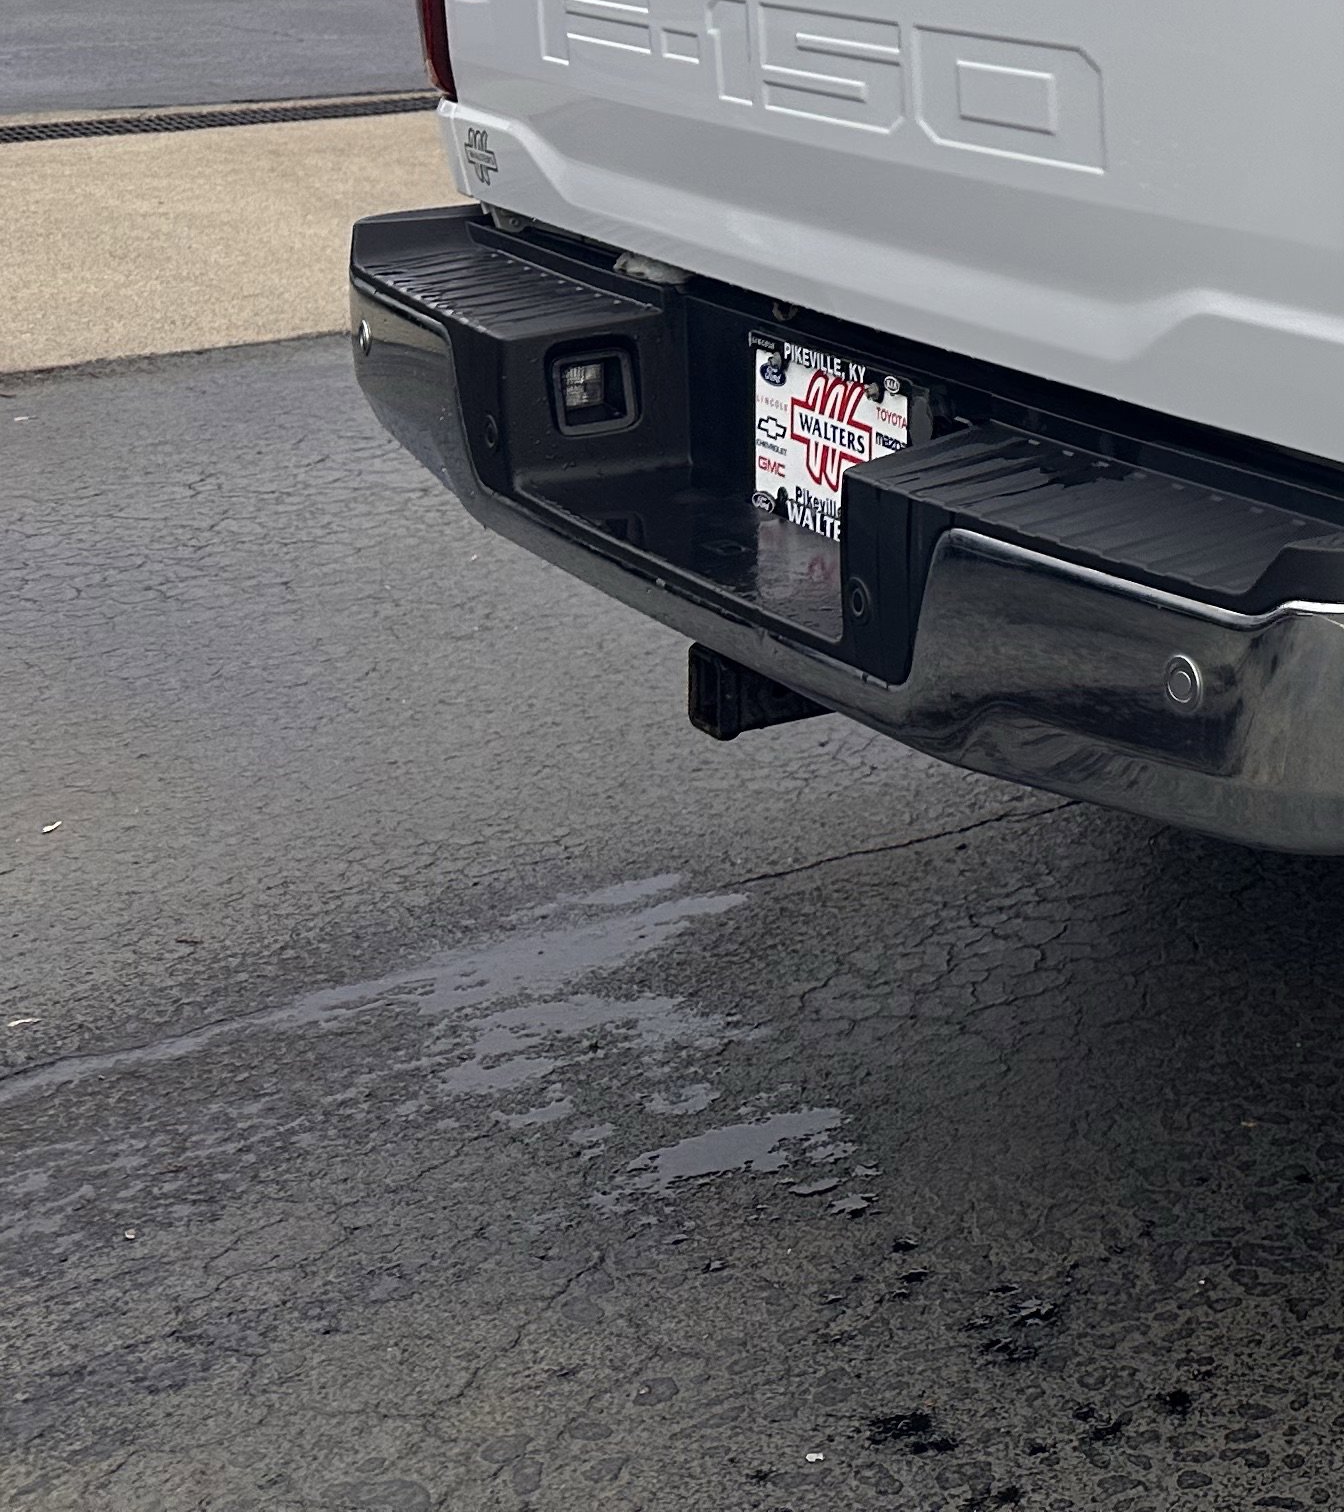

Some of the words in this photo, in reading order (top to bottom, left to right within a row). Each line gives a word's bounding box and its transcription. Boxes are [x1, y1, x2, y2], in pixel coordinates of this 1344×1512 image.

[783, 342, 846, 380] PIKEVILLE,
[849, 363, 866, 383] KY
[799, 412, 866, 454] WALTERS
[876, 407, 908, 429] TOYOTA
[758, 455, 786, 478] GMC
[786, 500, 841, 542] WALTE
